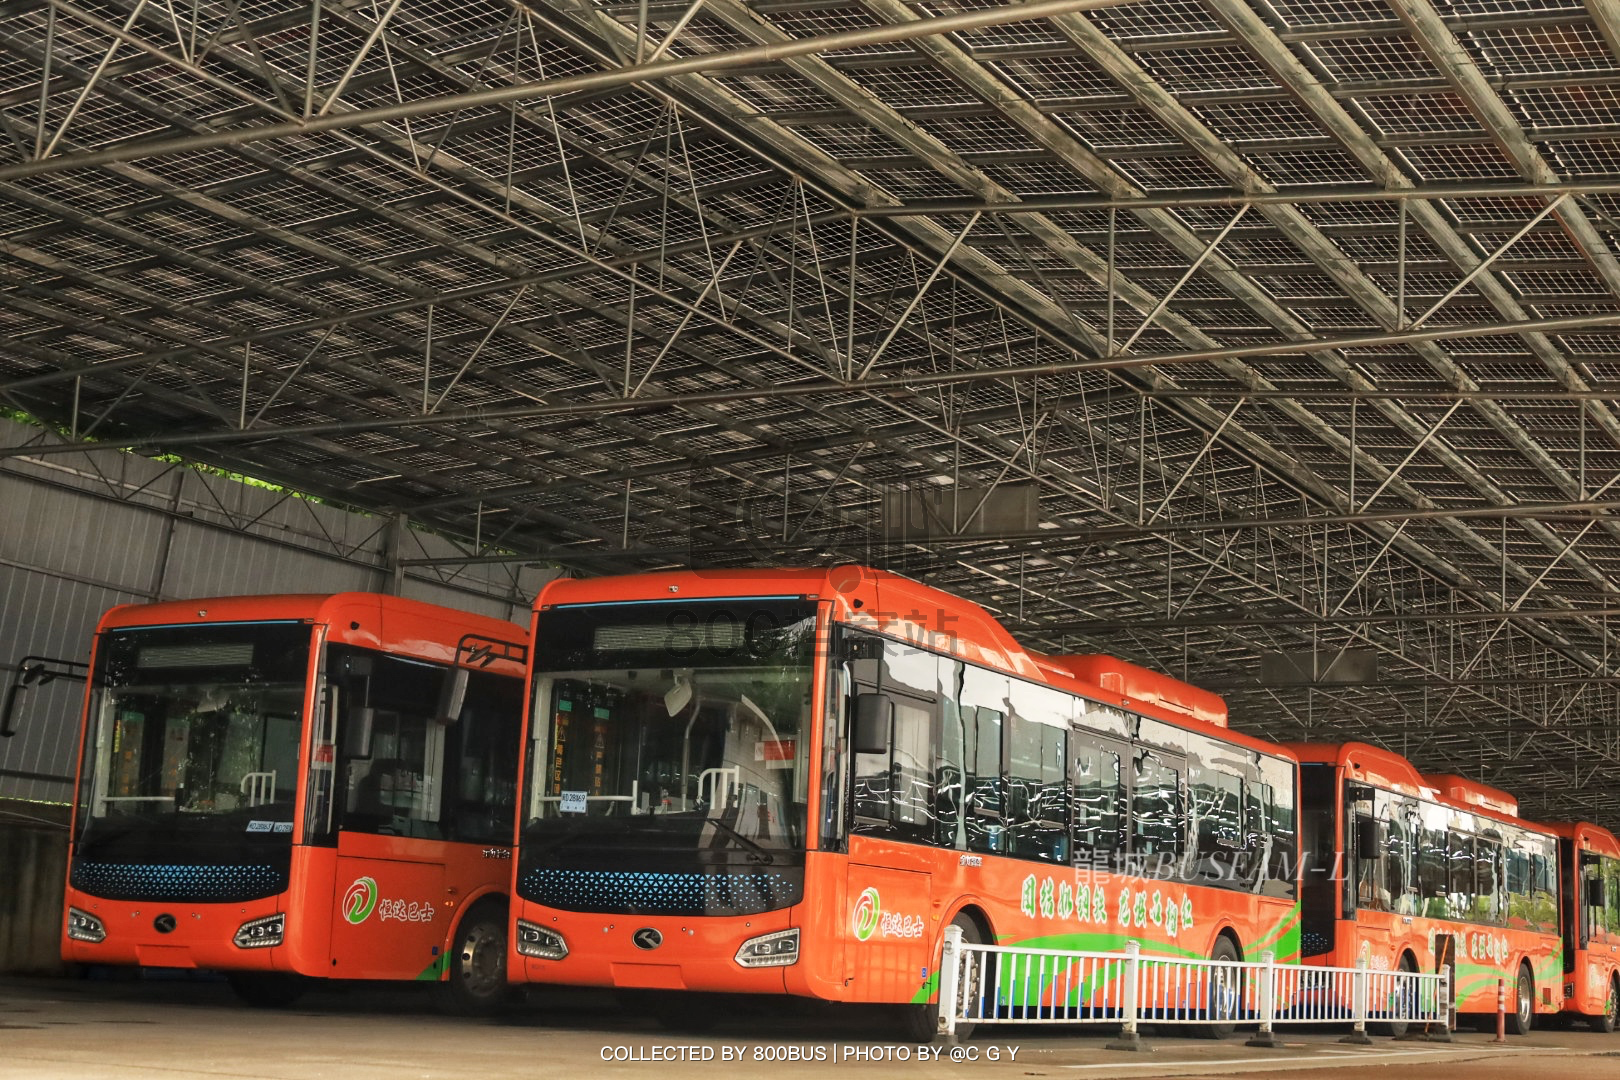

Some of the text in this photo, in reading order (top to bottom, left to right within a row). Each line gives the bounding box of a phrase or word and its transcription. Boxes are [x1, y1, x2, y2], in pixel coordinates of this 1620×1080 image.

[379, 898, 435, 922] 恒达巴士
[881, 912, 925, 938] 恒达巴士
